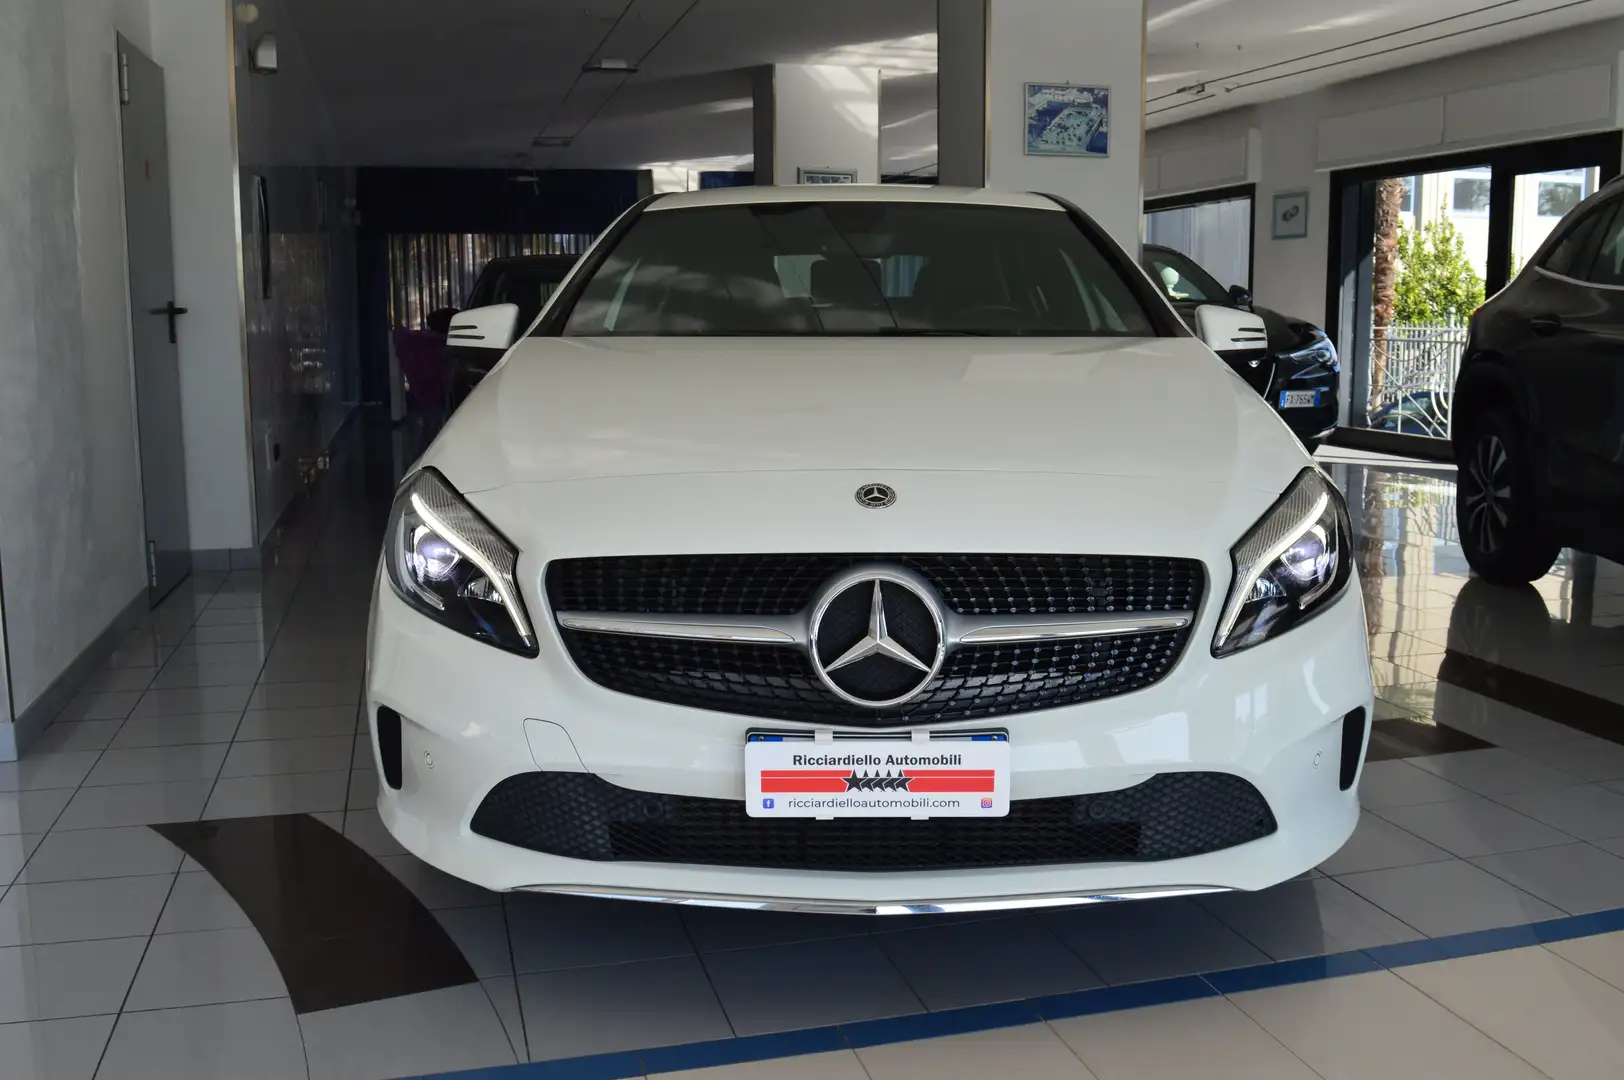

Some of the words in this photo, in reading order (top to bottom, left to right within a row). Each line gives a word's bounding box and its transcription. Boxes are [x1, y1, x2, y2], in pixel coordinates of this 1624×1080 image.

[793, 754, 881, 766] Ricciardiello
[885, 754, 962, 766] Automobili
[788, 798, 960, 808] ricciardielloautomobili.com
